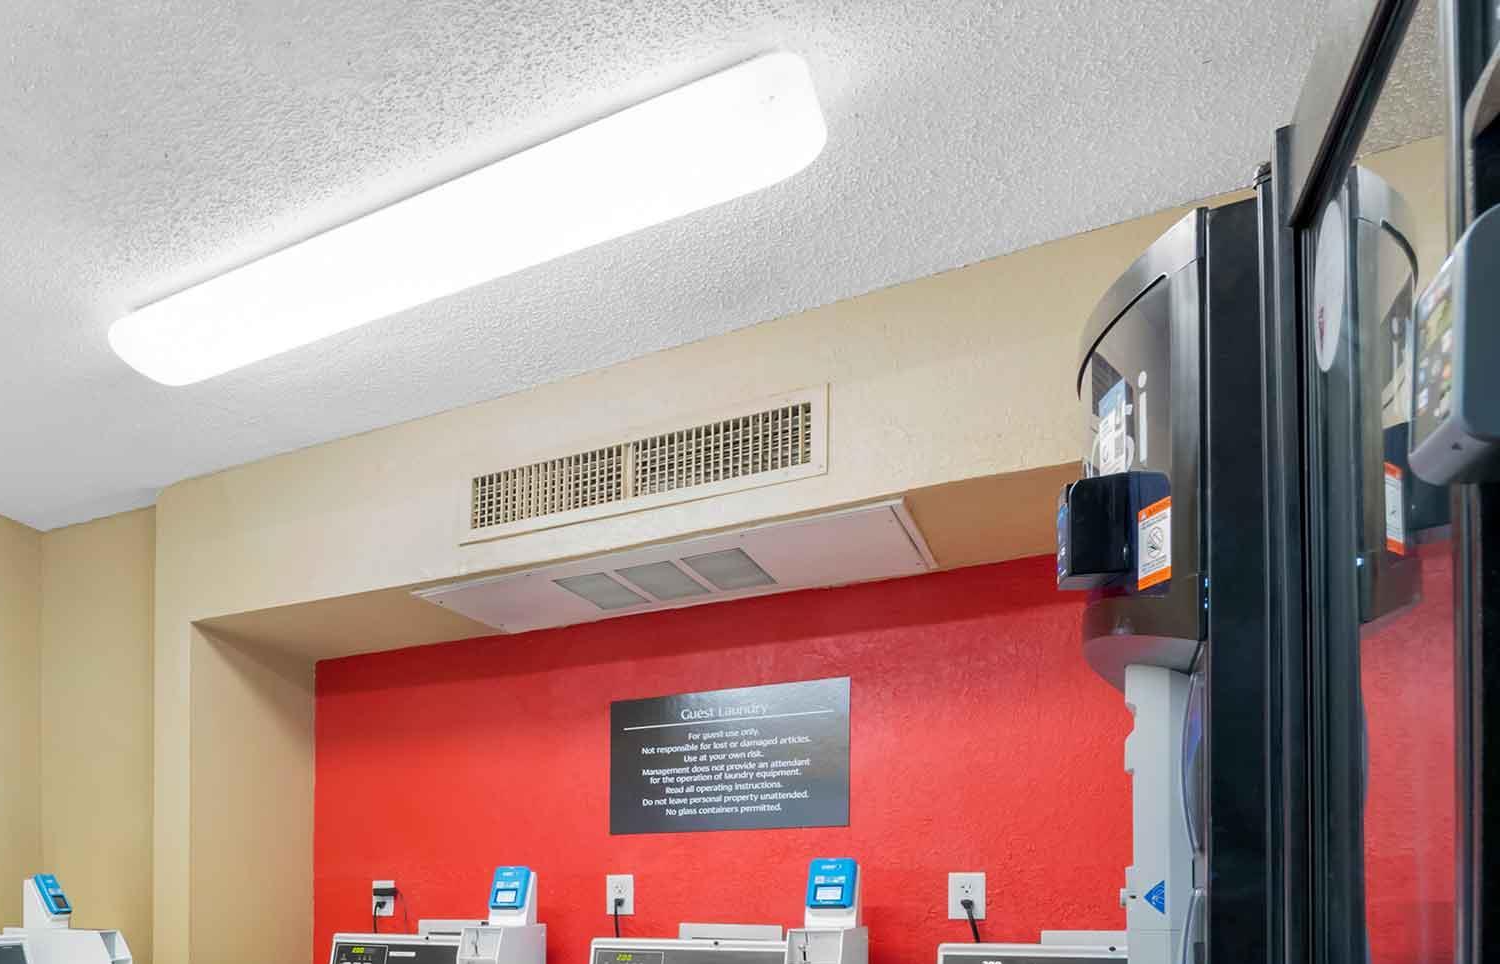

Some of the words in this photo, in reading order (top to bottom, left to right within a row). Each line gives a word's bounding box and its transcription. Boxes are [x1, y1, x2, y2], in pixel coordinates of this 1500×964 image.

[681, 707, 714, 720] Guest
[718, 704, 768, 717] Laundry
[688, 732, 700, 741] For
[702, 731, 724, 741] guest
[725, 730, 739, 738] use
[642, 746, 655, 755] Not
[656, 743, 698, 755] responsible
[700, 742, 712, 750] for
[713, 741, 728, 749] lost
[739, 736, 778, 748] damaged
[684, 755, 697, 763] Use
[699, 754, 707, 762] at
[708, 753, 727, 762] your
[728, 752, 746, 760] own
[642, 766, 690, 776] Management
[691, 765, 710, 773] does
[711, 764, 725, 772] not
[726, 762, 757, 772] provide
[770, 758, 810, 768] attendant
[649, 776, 661, 785] for
[662, 775, 675, 784] the
[676, 773, 713, 784] operation
[714, 772, 723, 780] of
[724, 770, 754, 780] laundry
[755, 768, 802, 778] equipment.
[665, 786, 684, 794] Read
[685, 785, 695, 793] all
[696, 783, 733, 793] operating
[668, 796, 688, 805] leave
[689, 794, 723, 805] personal
[724, 792, 759, 803] property
[760, 790, 809, 800] unattended.
[666, 808, 677, 816] No
[678, 806, 697, 817] glass
[698, 805, 740, 815] containers
[740, 803, 782, 813] permitted.
